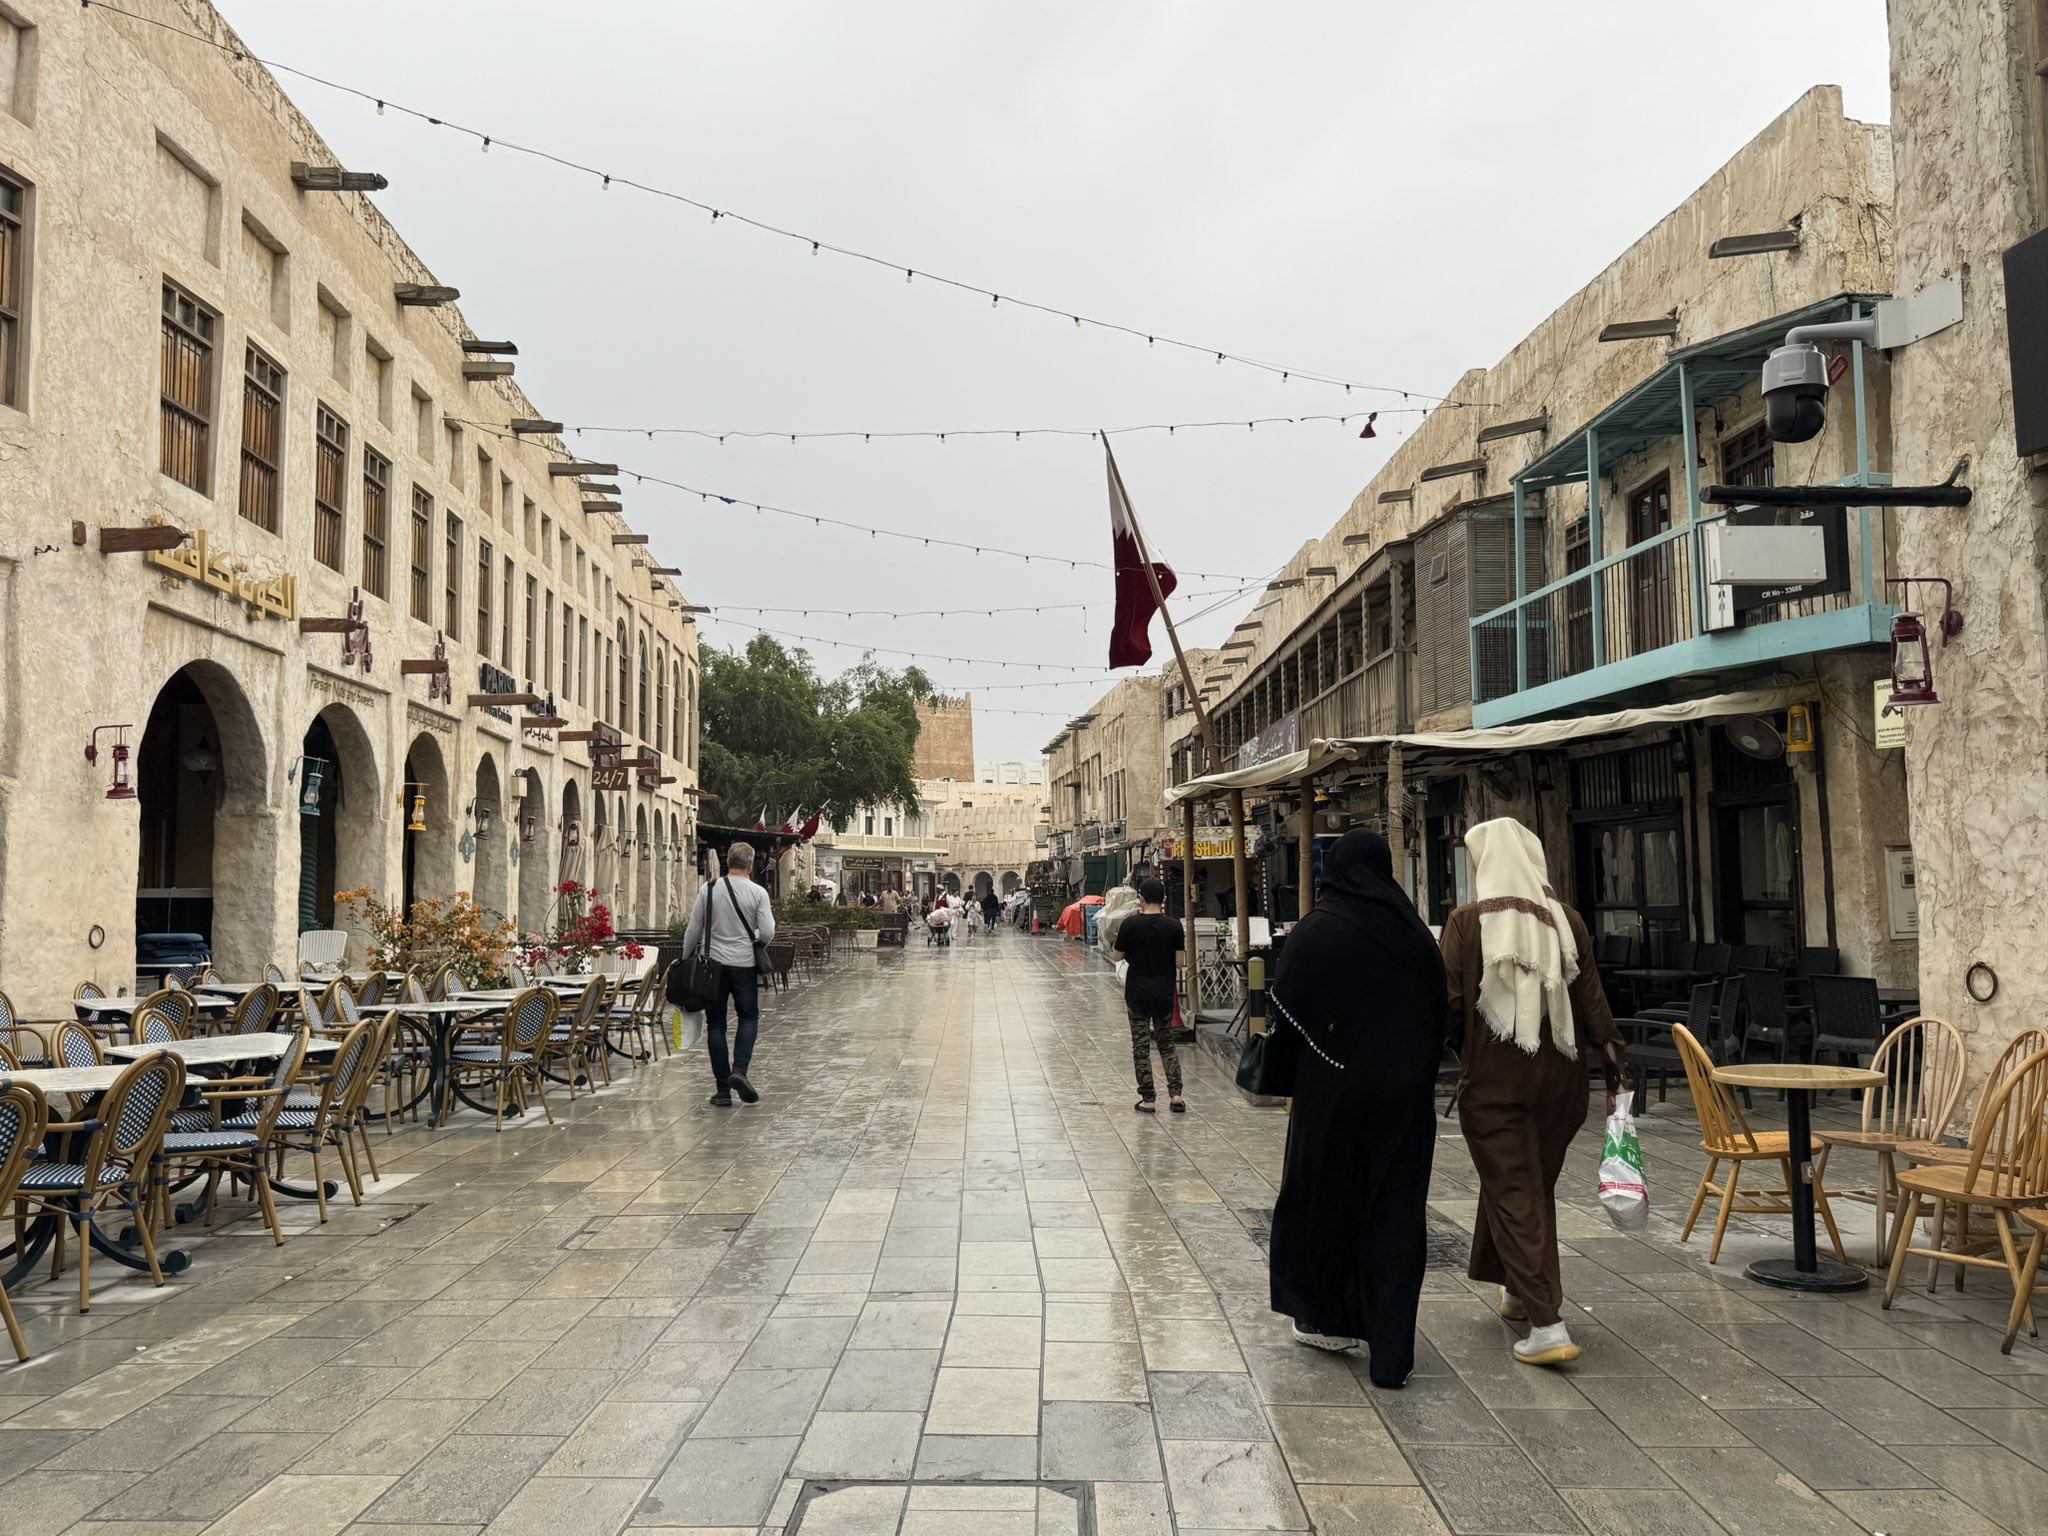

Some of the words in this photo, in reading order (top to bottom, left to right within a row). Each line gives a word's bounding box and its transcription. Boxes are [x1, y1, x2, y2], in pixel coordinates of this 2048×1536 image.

[1761, 590, 1771, 599] CR
[592, 769, 625, 789] 24/7
[1173, 840, 1212, 857] FSH
[1215, 837, 1252, 857] JUIE
